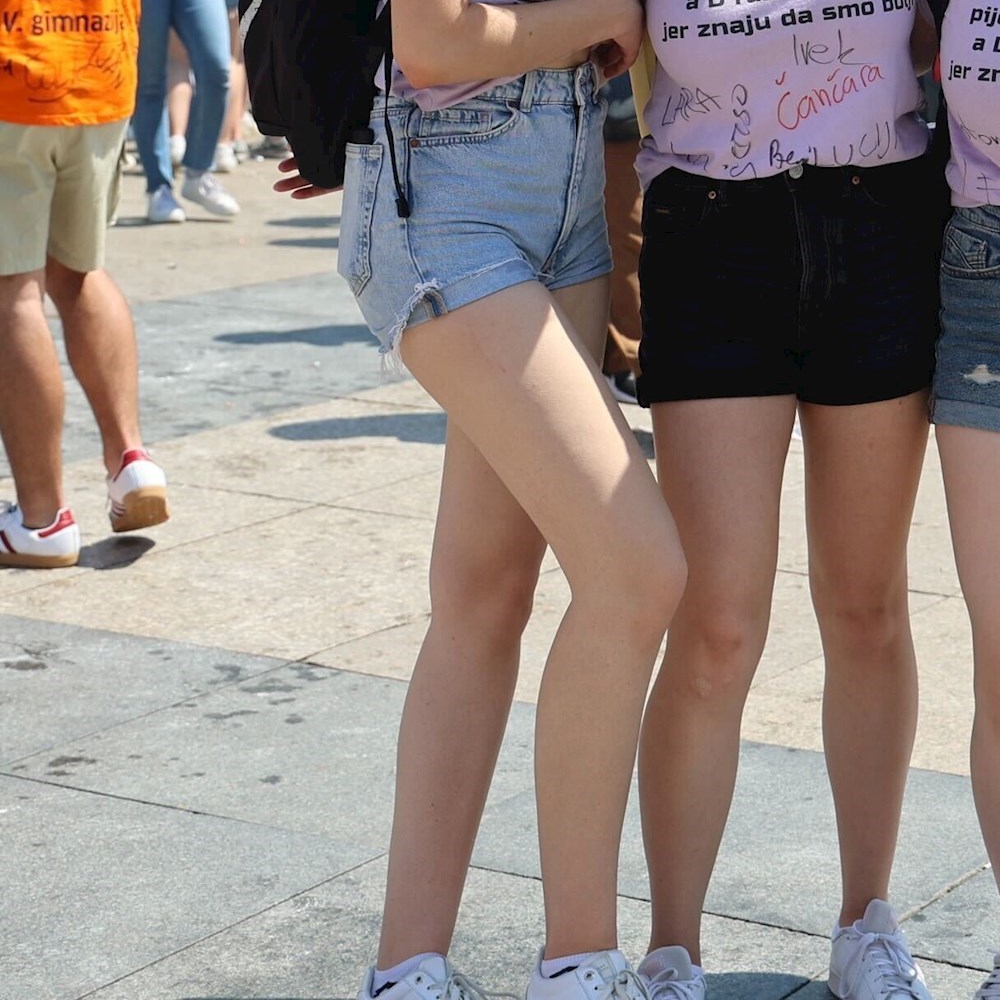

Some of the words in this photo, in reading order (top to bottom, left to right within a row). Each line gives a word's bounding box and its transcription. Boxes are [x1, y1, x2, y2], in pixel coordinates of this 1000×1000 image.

[661, 21, 689, 42] jer
[697, 14, 772, 38] znaju
[780, 7, 814, 27] da
[971, 37, 985, 52] a
[948, 60, 971, 81] jer
